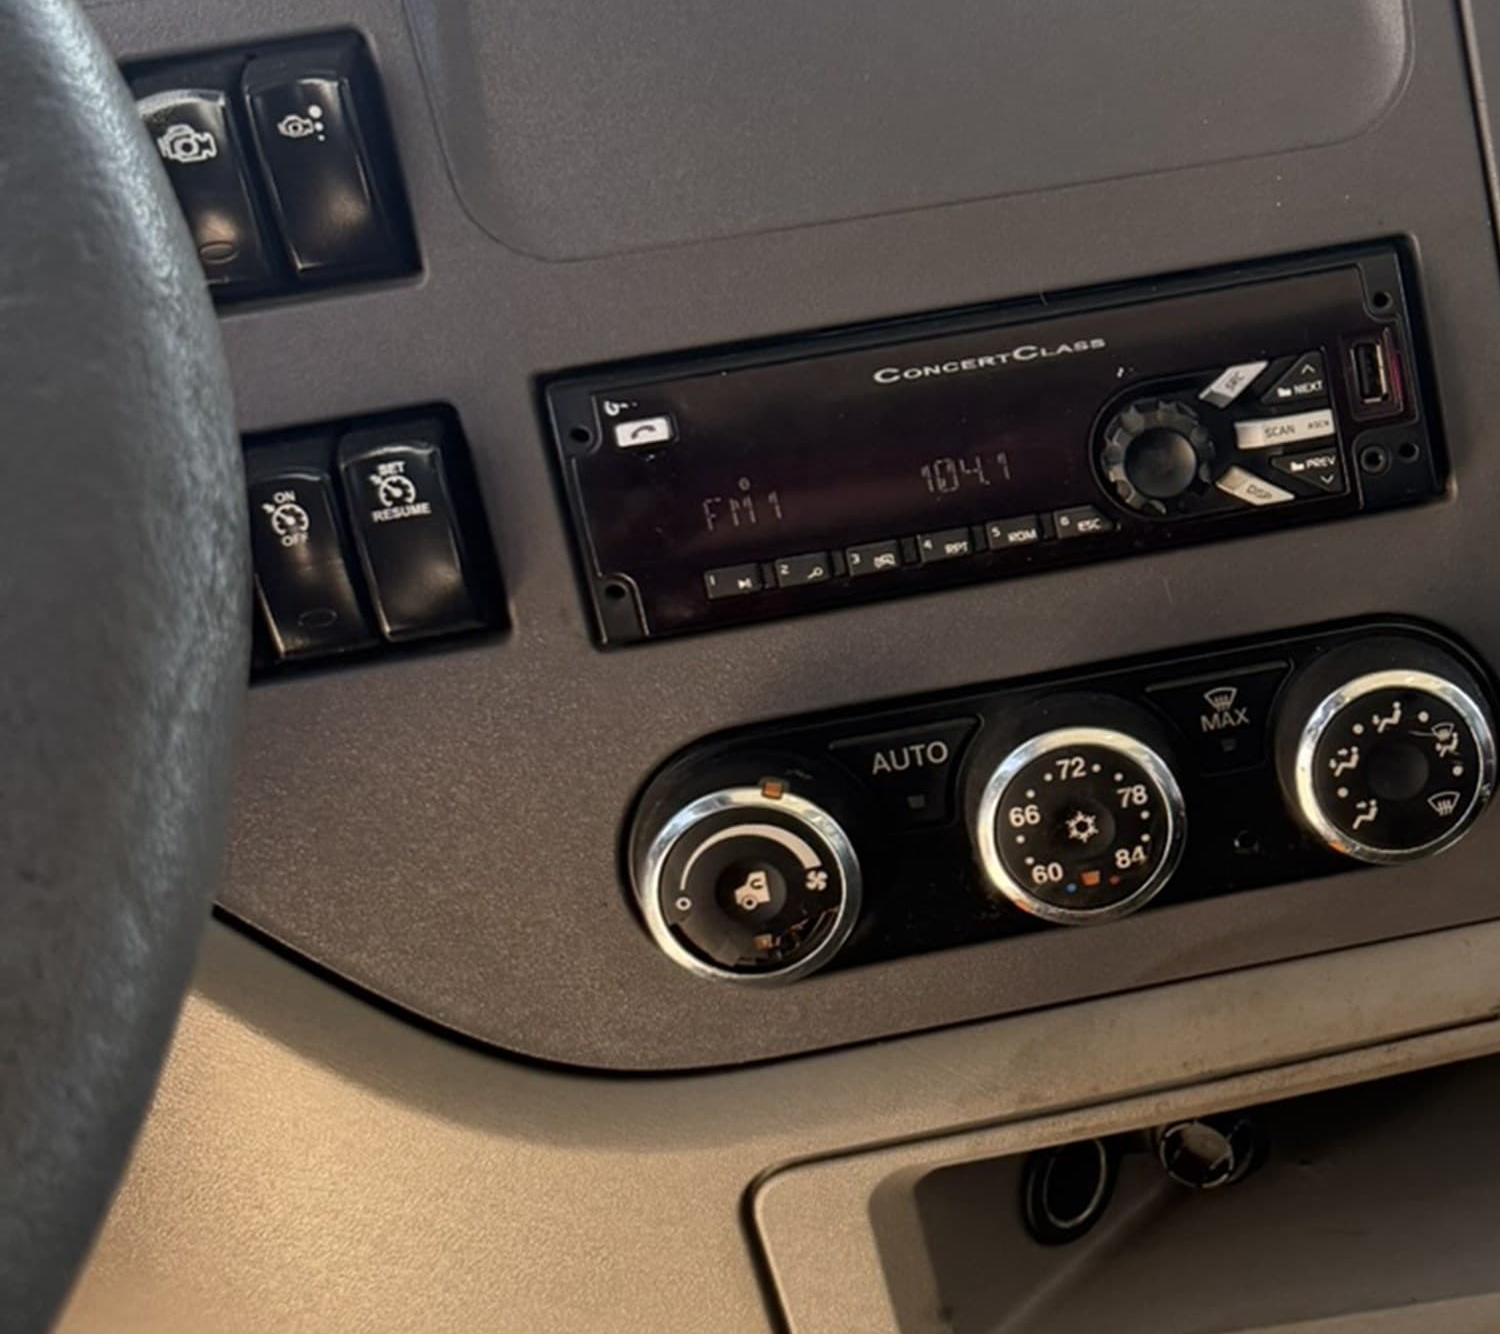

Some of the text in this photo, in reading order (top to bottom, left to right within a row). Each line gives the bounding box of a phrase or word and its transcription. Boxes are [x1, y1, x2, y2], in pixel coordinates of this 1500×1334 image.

[1294, 380, 1323, 395] NEXT
[1264, 424, 1296, 438] SCAN
[377, 461, 405, 476] SET
[1306, 456, 1336, 469] PREV
[273, 491, 296, 503] ON
[371, 502, 432, 522] RESUME
[1200, 706, 1250, 733] MAX
[871, 741, 949, 775] AUTO
[1056, 756, 1087, 780] 72
[1116, 784, 1148, 809] 78
[1009, 804, 1041, 827] 66
[1115, 845, 1147, 869] 84
[1032, 862, 1064, 884] 60
